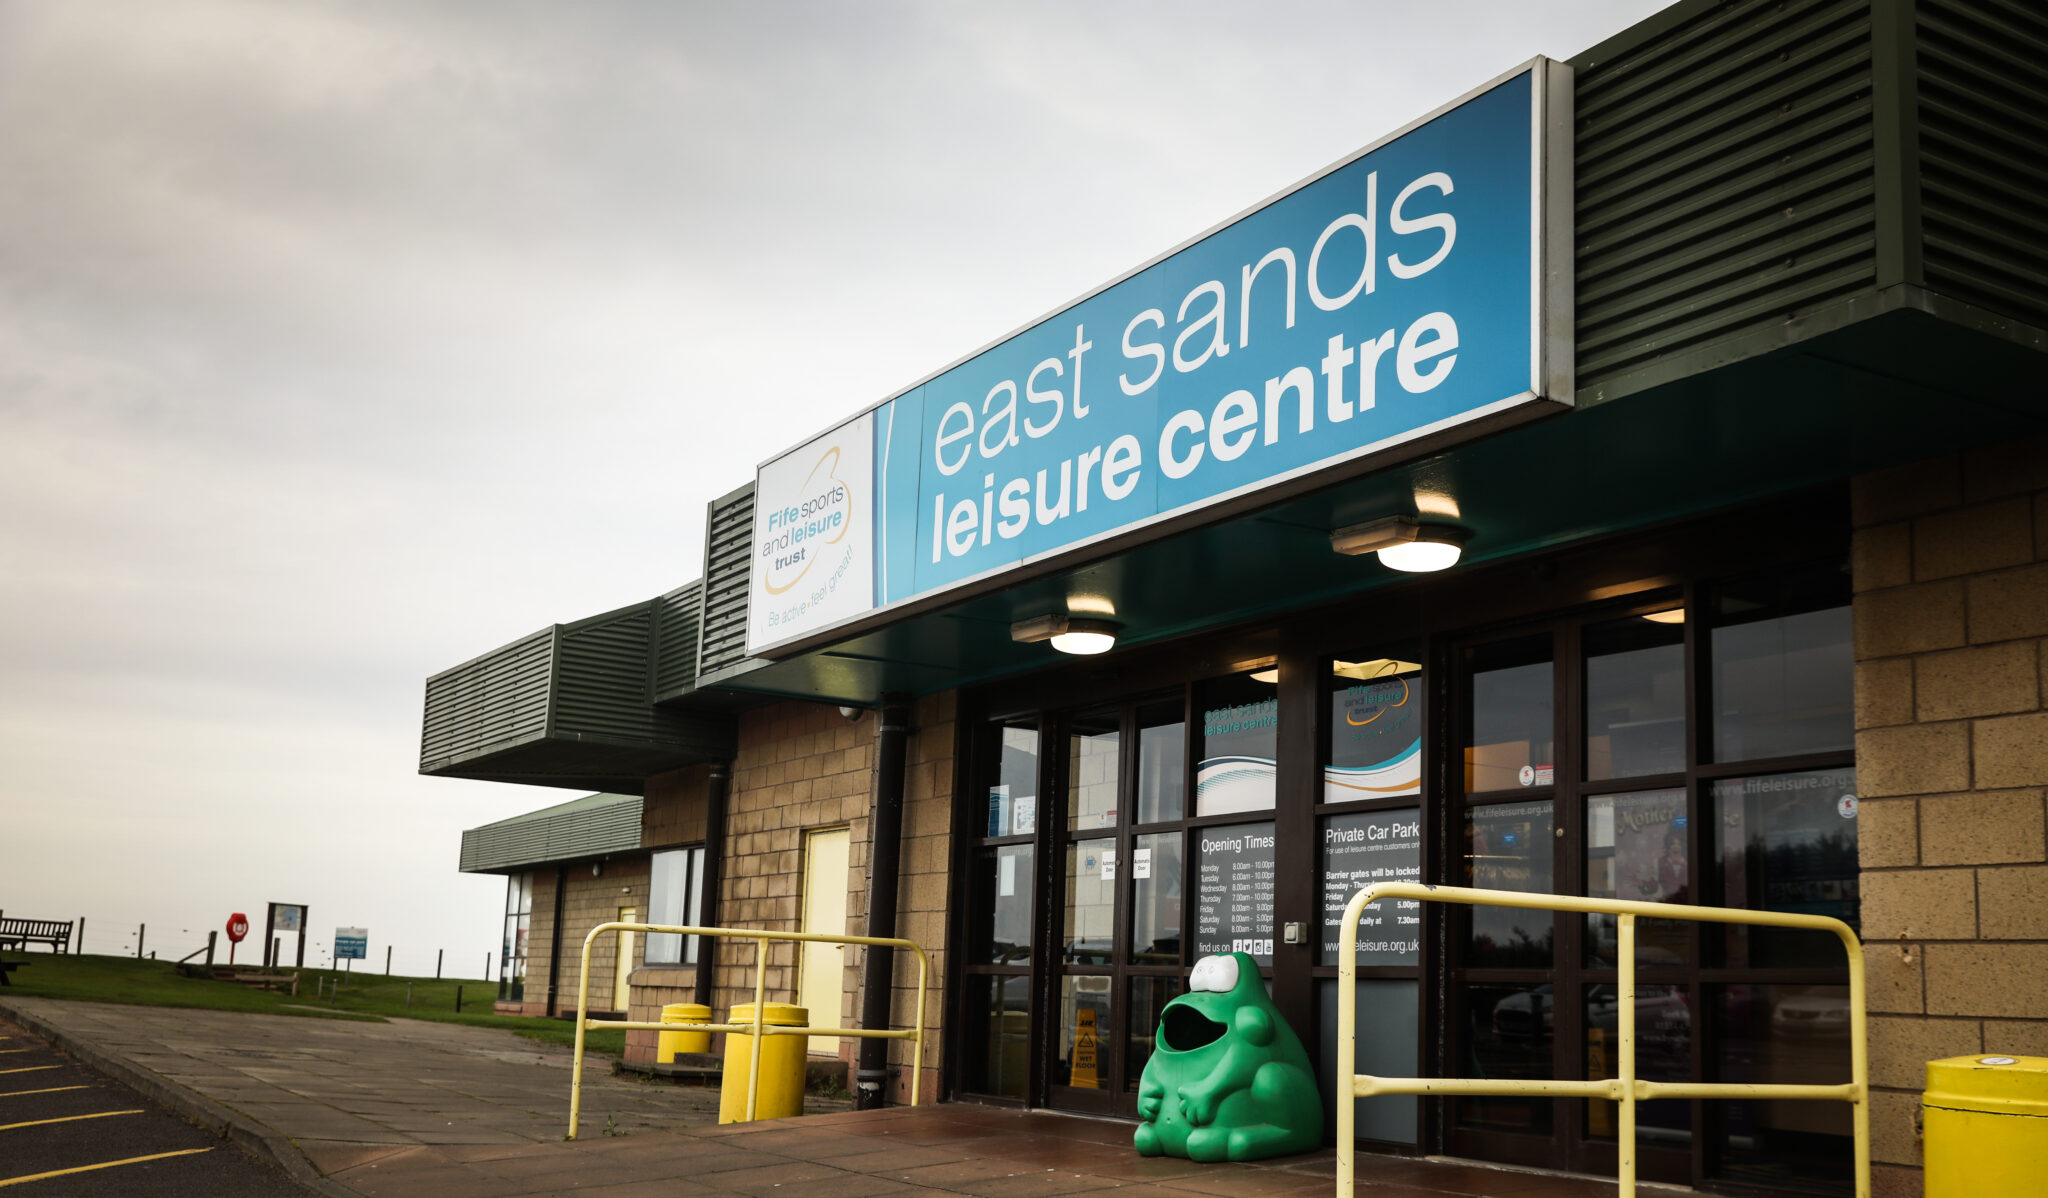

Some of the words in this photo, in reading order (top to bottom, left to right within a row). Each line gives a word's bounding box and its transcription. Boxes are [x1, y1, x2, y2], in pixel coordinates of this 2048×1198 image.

[935, 324, 1093, 477] east
[1119, 170, 1457, 397] sands
[931, 434, 1142, 563] leisure
[1158, 311, 1459, 480] centre
[768, 506, 799, 532] Fife
[801, 486, 843, 519] sports
[762, 529, 789, 557] and
[791, 511, 842, 545] leisure
[775, 547, 805, 570] trust
[768, 611, 780, 627] Be
[782, 602, 806, 624] active
[1366, 691, 1402, 704] leisure
[1204, 703, 1231, 723] east
[1237, 696, 1278, 717] sands
[1204, 721, 1240, 736] leisure
[1242, 715, 1278, 730] centre
[1710, 775, 1857, 796] www.fifeleisure.org.
[1326, 827, 1364, 844] Private
[1367, 825, 1389, 840] Car
[1392, 821, 1419, 838] Park
[1202, 837, 1242, 855] Opening
[1244, 835, 1275, 849] Times
[1200, 864, 1219, 873] Monday
[1326, 871, 1349, 880] Barrier
[1350, 869, 1370, 880] gates
[1371, 868, 1384, 877] will
[1385, 868, 1394, 876] be
[1396, 866, 1420, 876] locked
[1200, 874, 1219, 883] Tuesday
[1200, 884, 1227, 893] Wednesday
[1326, 882, 1349, 891] Monday
[1200, 895, 1221, 904] Thursday
[1326, 893, 1343, 902] Friday
[1200, 905, 1214, 914] Friday
[1397, 901, 1420, 910] 5.00pm
[1200, 915, 1220, 924] Saturday
[1325, 918, 1342, 926] Gates
[1360, 917, 1374, 926] daily
[1375, 917, 1382, 925] at
[1397, 916, 1420, 924] 7.30am
[1200, 926, 1217, 935] Sunday
[1199, 942, 1211, 952] find
[1212, 944, 1220, 952] us
[1221, 944, 1231, 952] on
